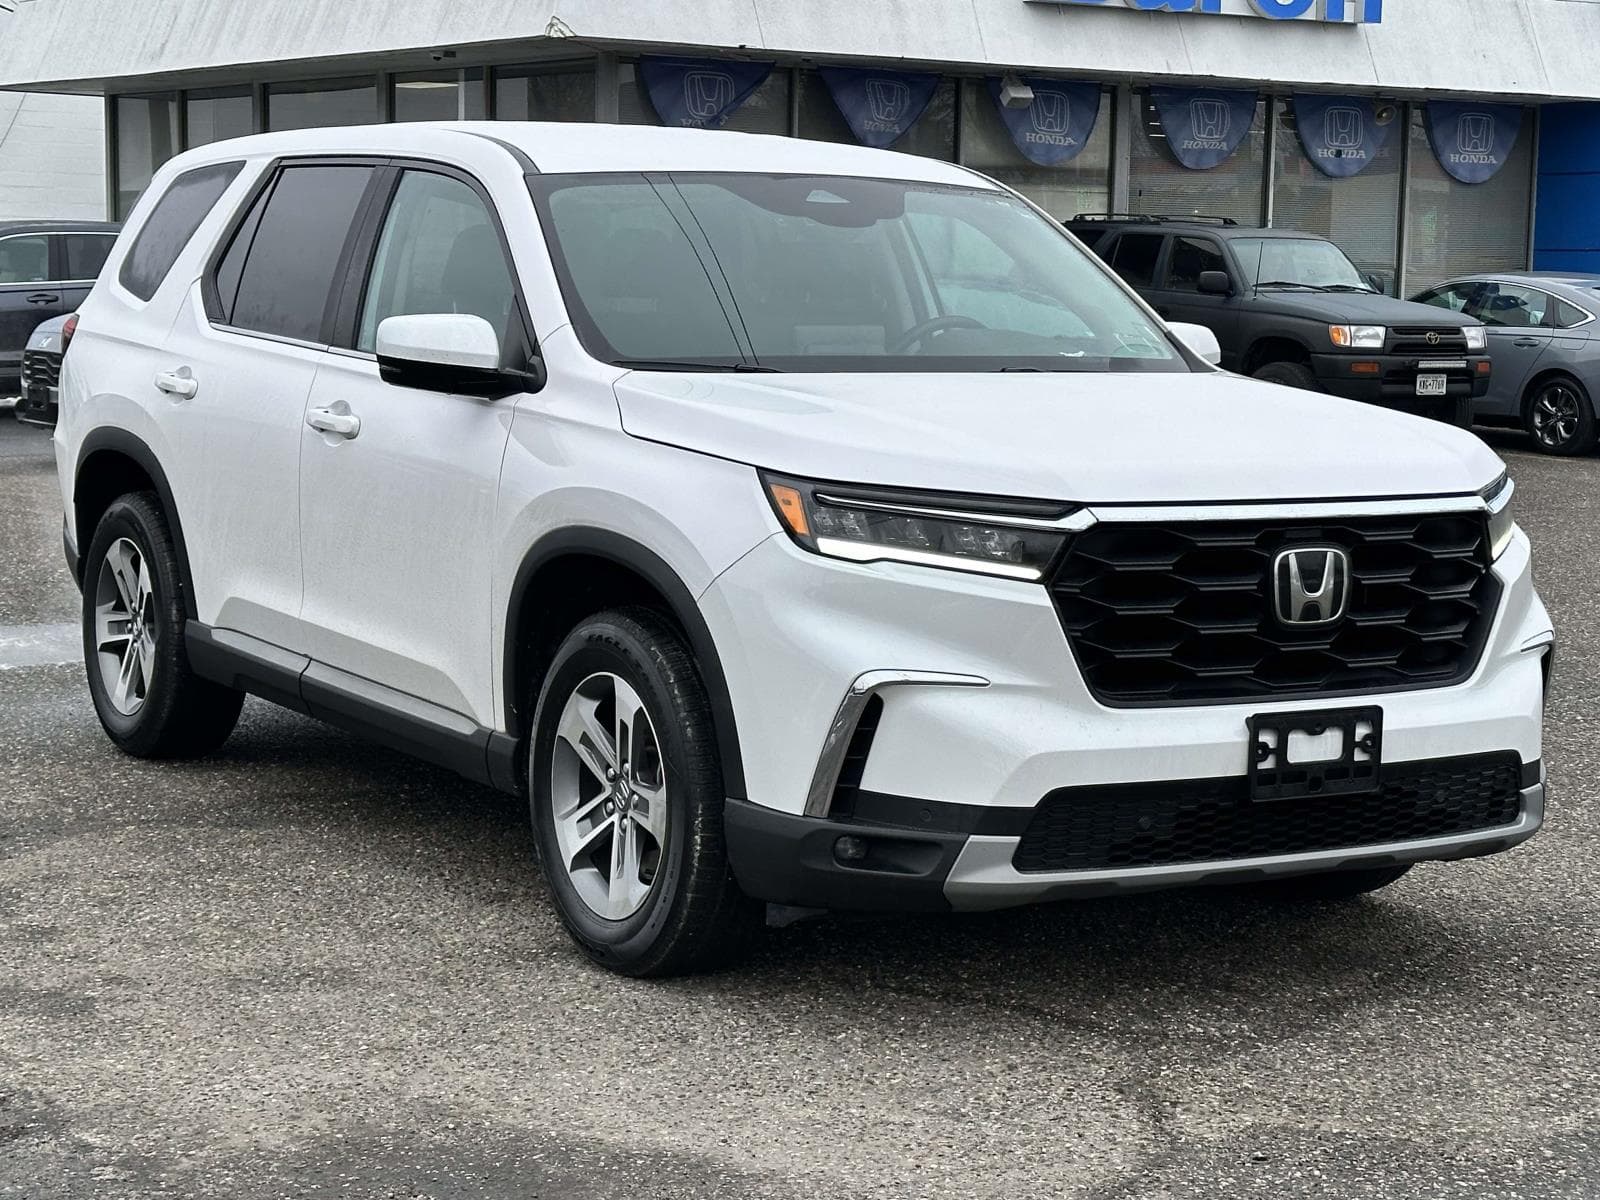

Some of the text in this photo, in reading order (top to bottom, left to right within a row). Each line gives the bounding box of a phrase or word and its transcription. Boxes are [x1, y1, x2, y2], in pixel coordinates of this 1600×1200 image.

[1025, 132, 1078, 146] HONDA
[1182, 140, 1228, 150] HONDA
[1317, 148, 1367, 159] HONDA
[1449, 153, 1498, 164] HONDA
